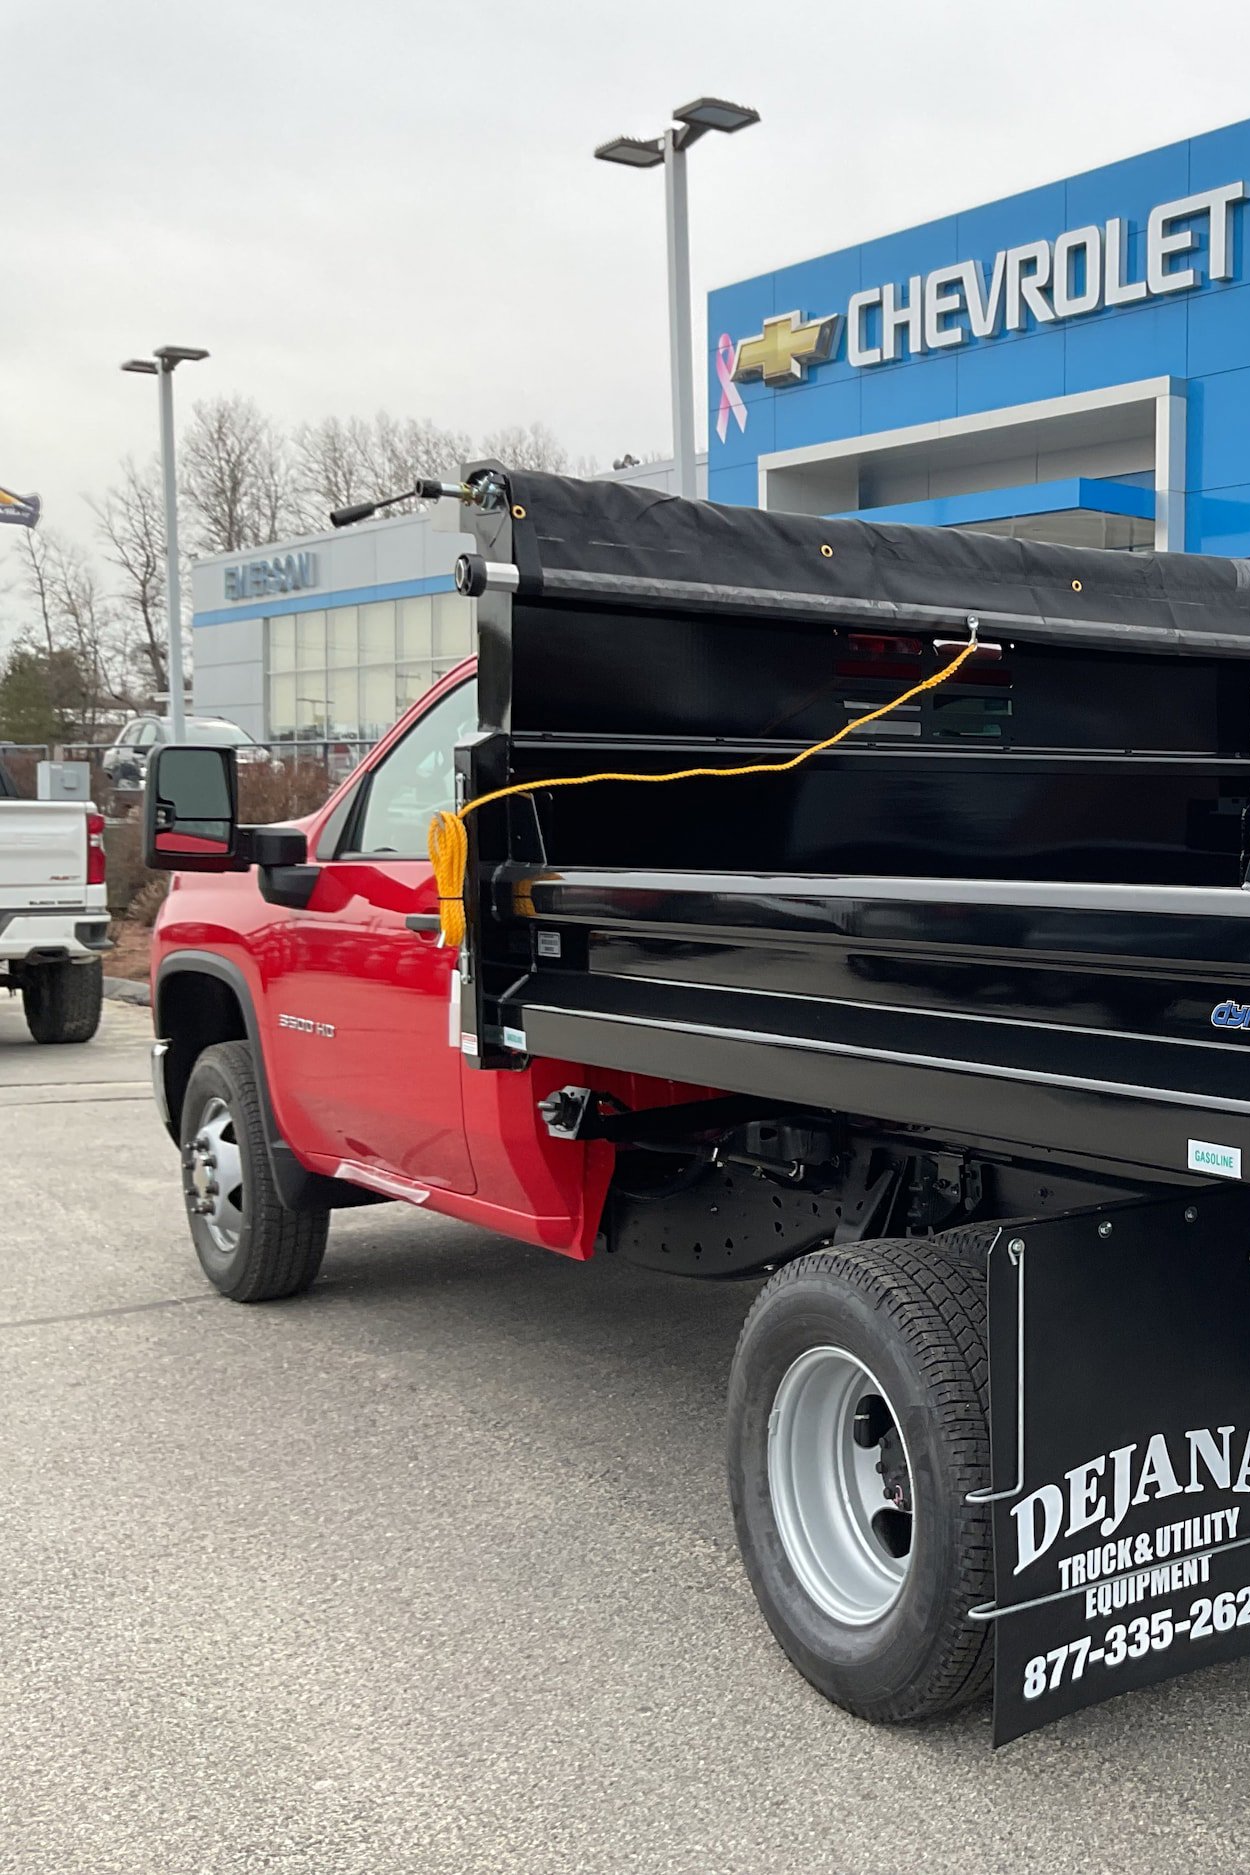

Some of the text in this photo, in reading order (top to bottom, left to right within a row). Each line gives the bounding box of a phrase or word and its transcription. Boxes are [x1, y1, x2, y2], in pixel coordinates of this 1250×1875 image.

[224, 551, 317, 601] EMERSON
[316, 1022, 336, 1038] HD
[1194, 1150, 1234, 1169] GASOLINE
[1085, 1554, 1213, 1620] EQUIPMENT
